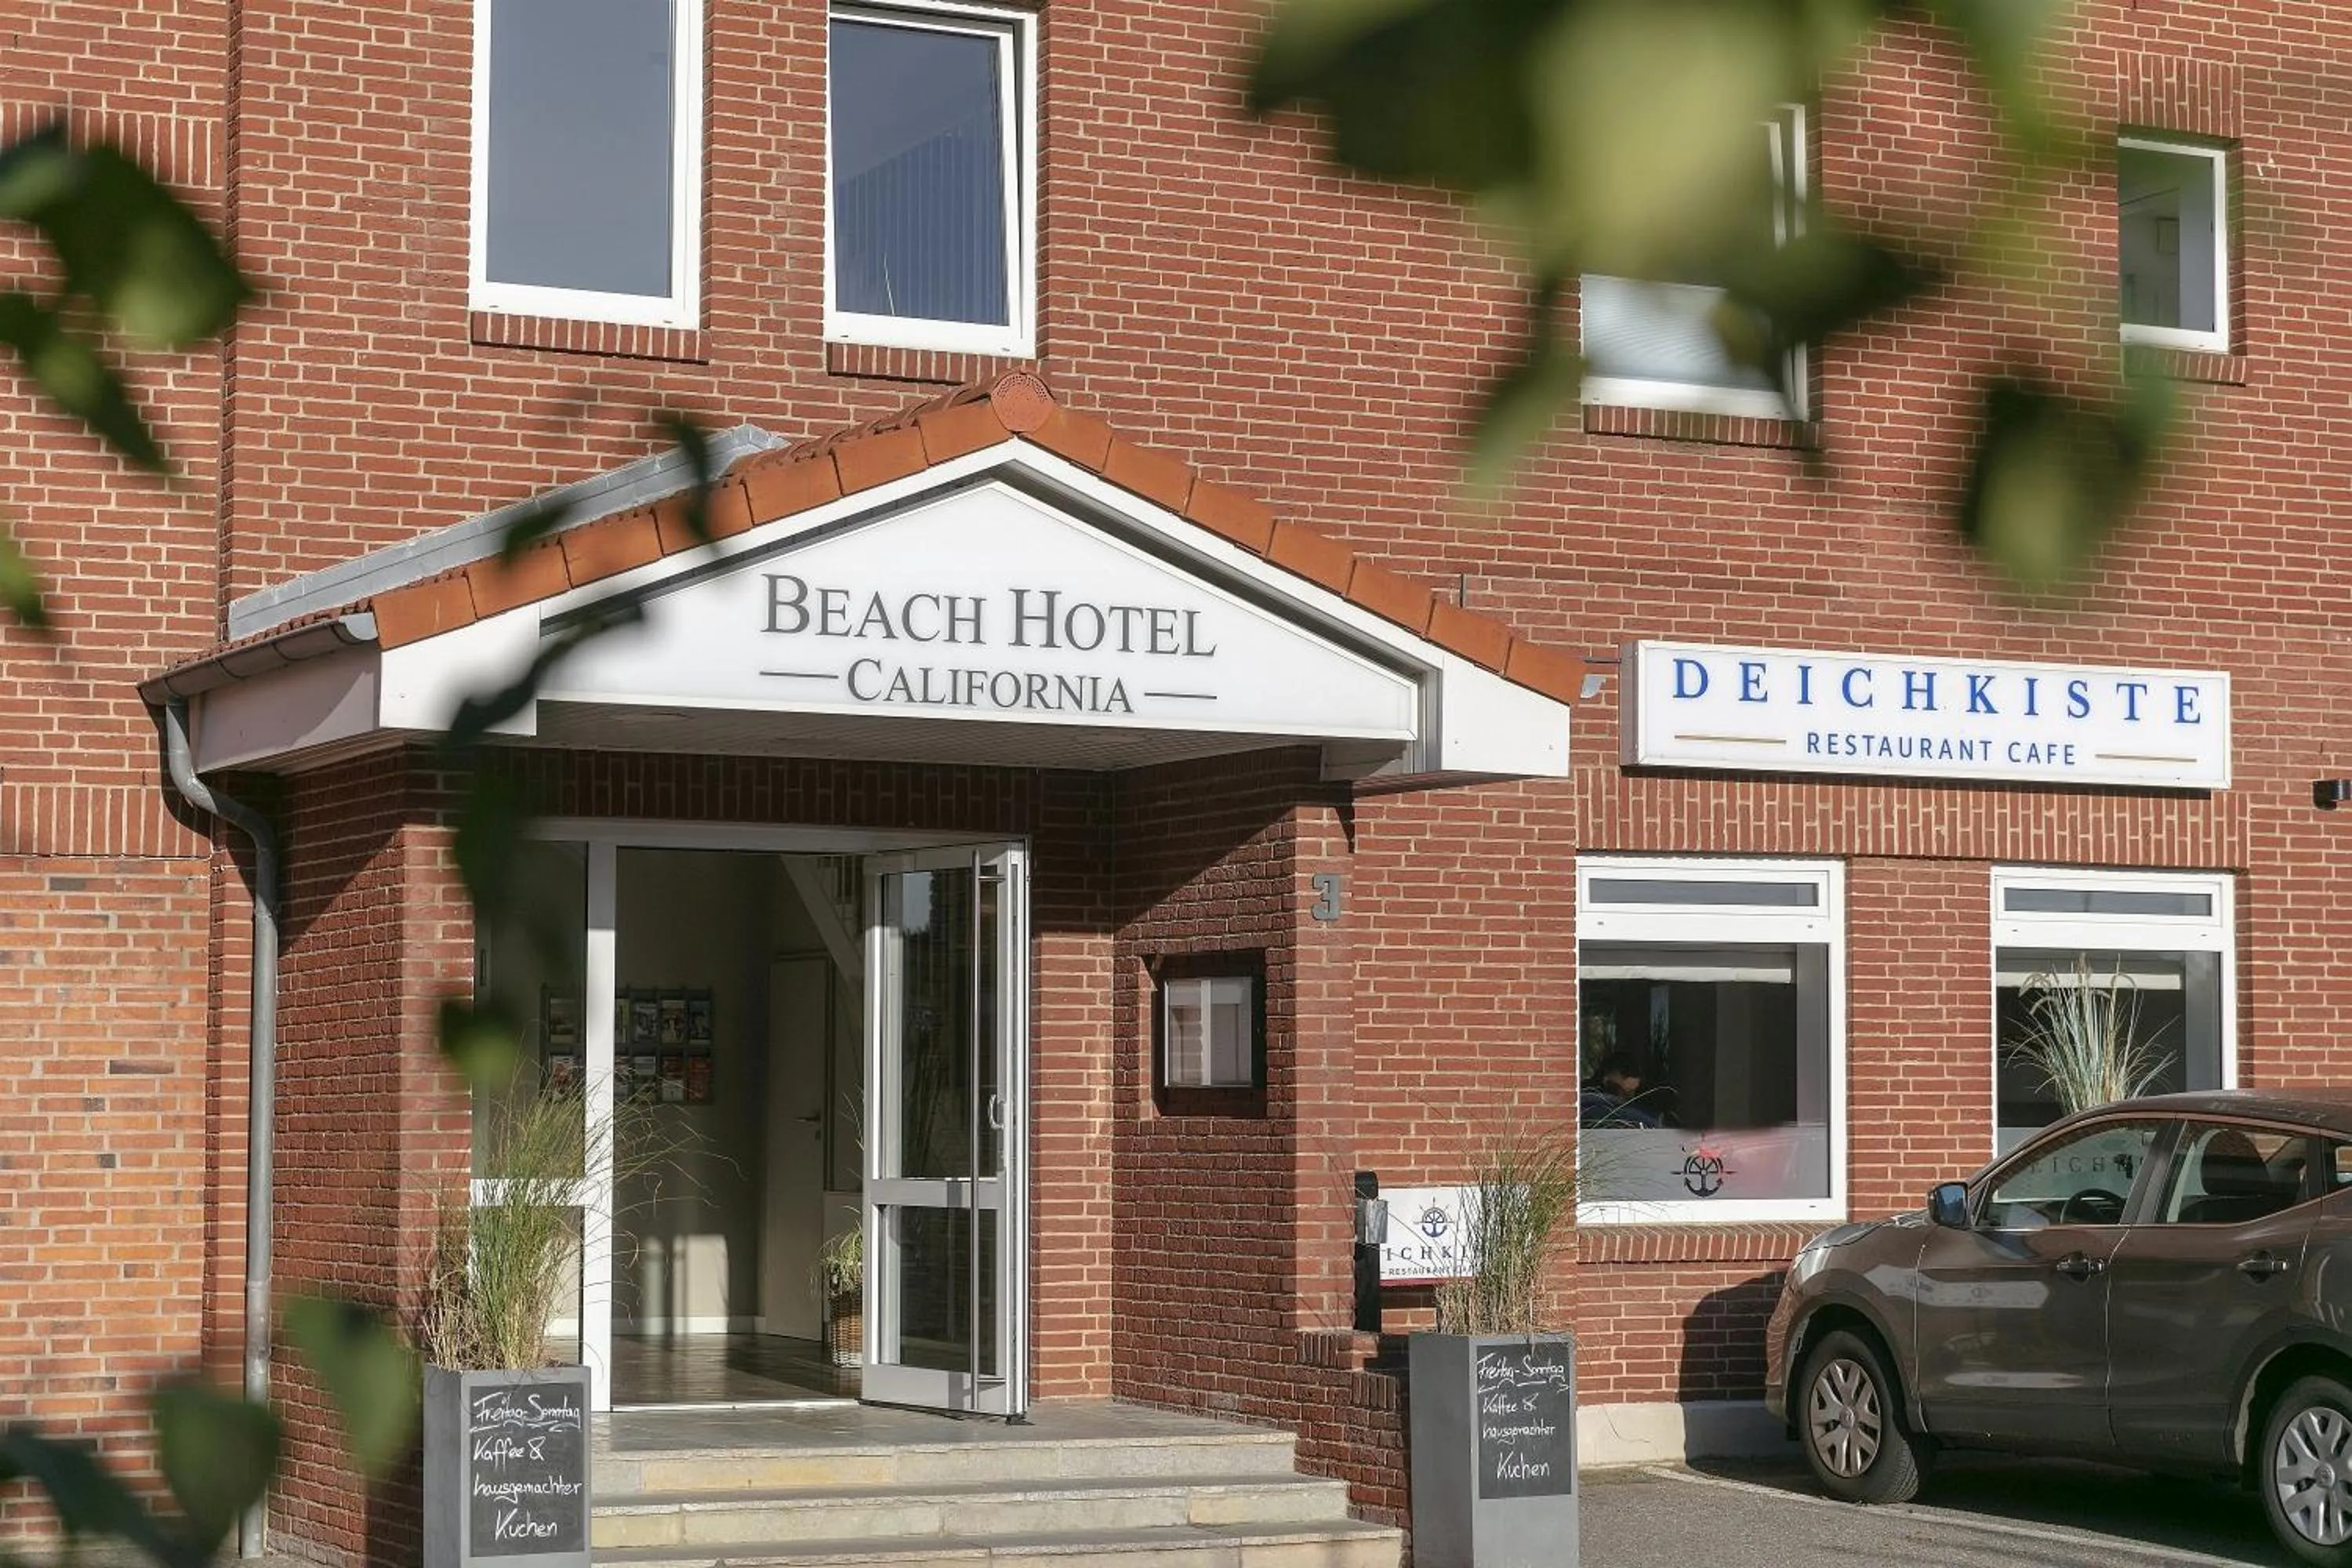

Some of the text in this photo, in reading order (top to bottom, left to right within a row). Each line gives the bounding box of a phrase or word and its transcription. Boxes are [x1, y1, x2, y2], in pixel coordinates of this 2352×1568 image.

[761, 573, 1218, 657] BEACH HOTEL
[847, 657, 1134, 713] CALIFORNIA
[1672, 657, 2202, 724] DEICHKISTE
[1806, 732, 2077, 767] RESTAURANT CAFE
[1310, 873, 1341, 921] 3
[473, 1436, 524, 1472] Kaffee
[1497, 1450, 1551, 1479] Kuchen
[495, 1508, 558, 1541] Kuchen
